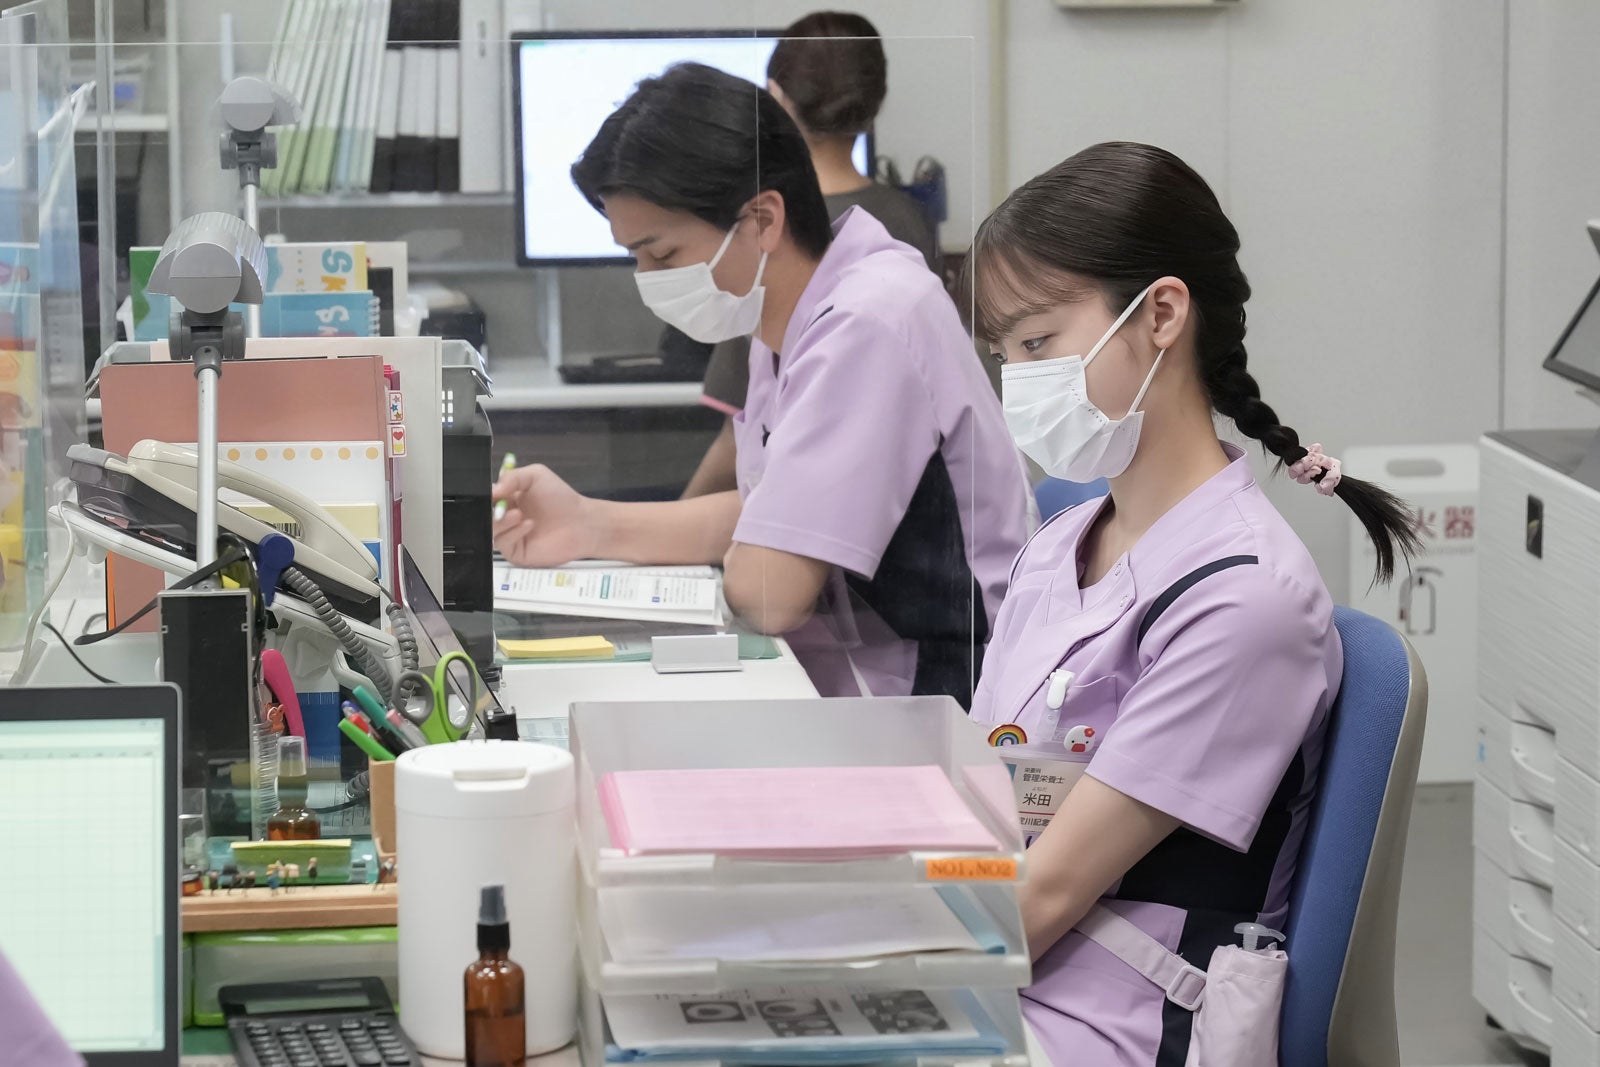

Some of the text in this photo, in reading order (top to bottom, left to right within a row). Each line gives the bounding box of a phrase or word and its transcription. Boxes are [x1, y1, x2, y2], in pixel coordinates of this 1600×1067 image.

[1023, 773, 1065, 785] 管理栄養士
[1022, 792, 1052, 807] 米田
